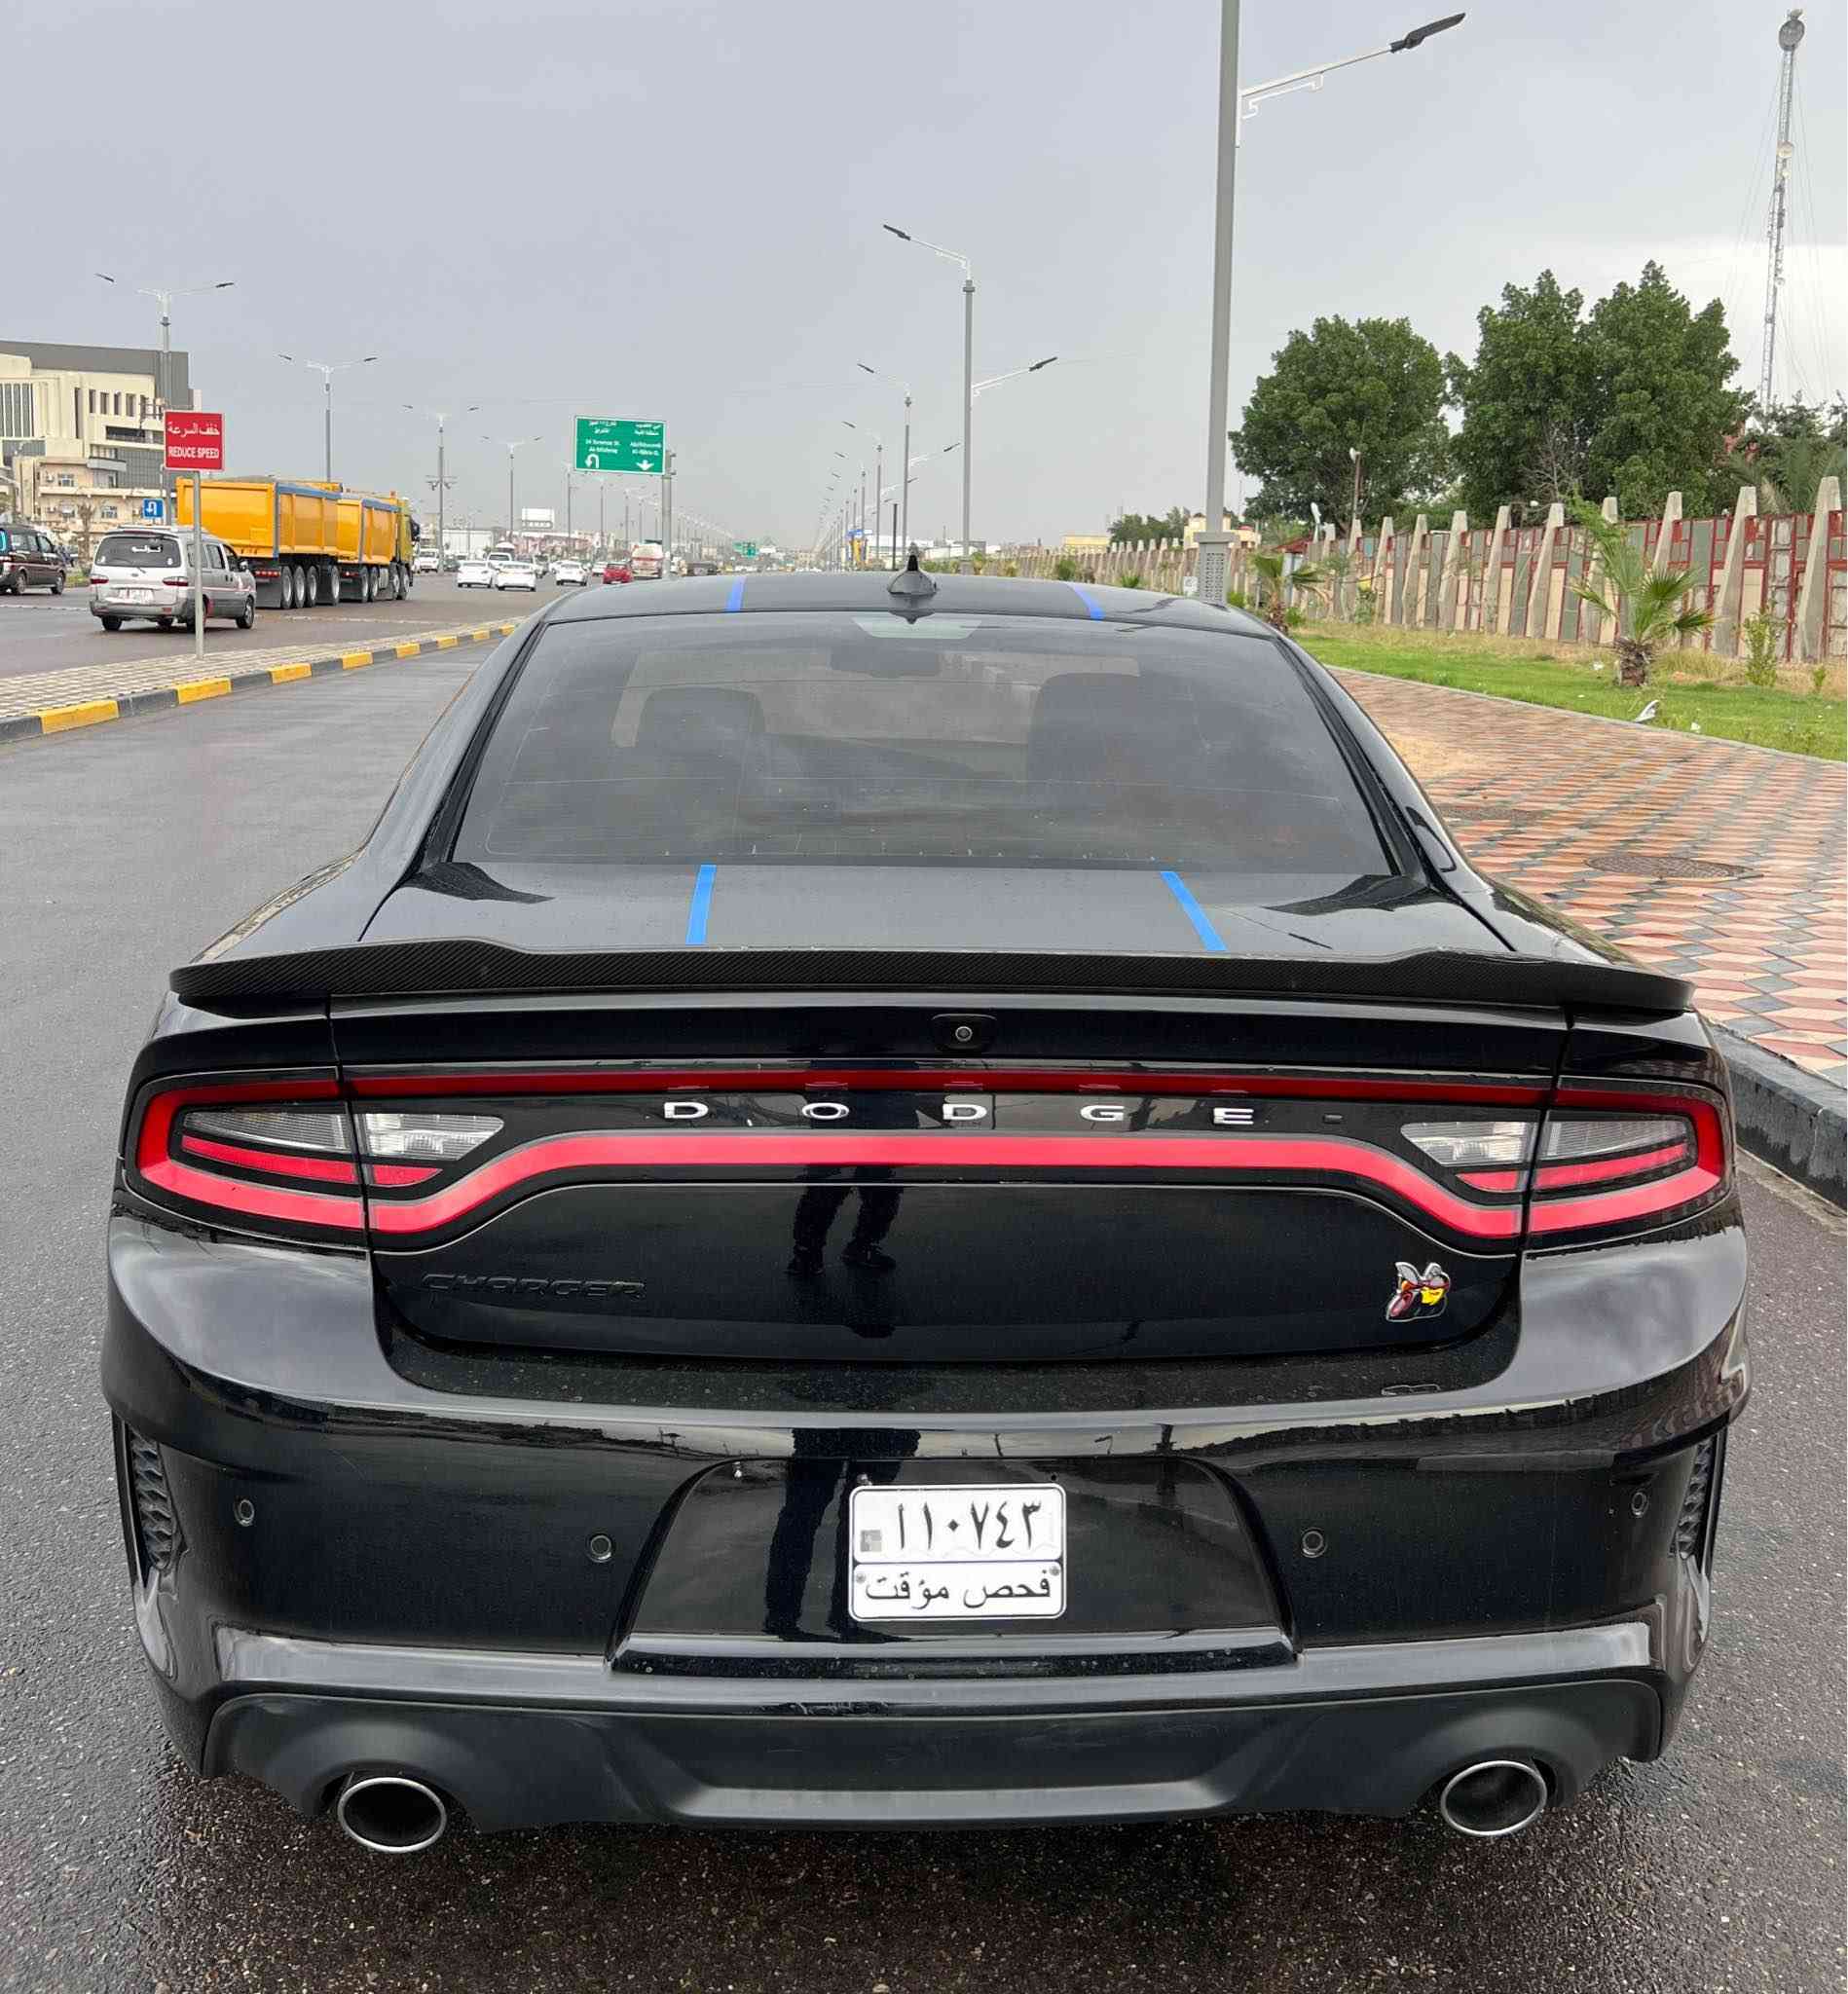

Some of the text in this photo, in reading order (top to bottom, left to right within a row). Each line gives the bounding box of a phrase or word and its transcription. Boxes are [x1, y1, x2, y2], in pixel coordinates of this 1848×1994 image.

[167, 422, 220, 437] خفف السرعة
[168, 446, 220, 460] REDUCE SPEED
[663, 1101, 1256, 1126] DODGE
[423, 1273, 647, 1300] CHARGER
[866, 1569, 1052, 1610] فحص مؤقت
